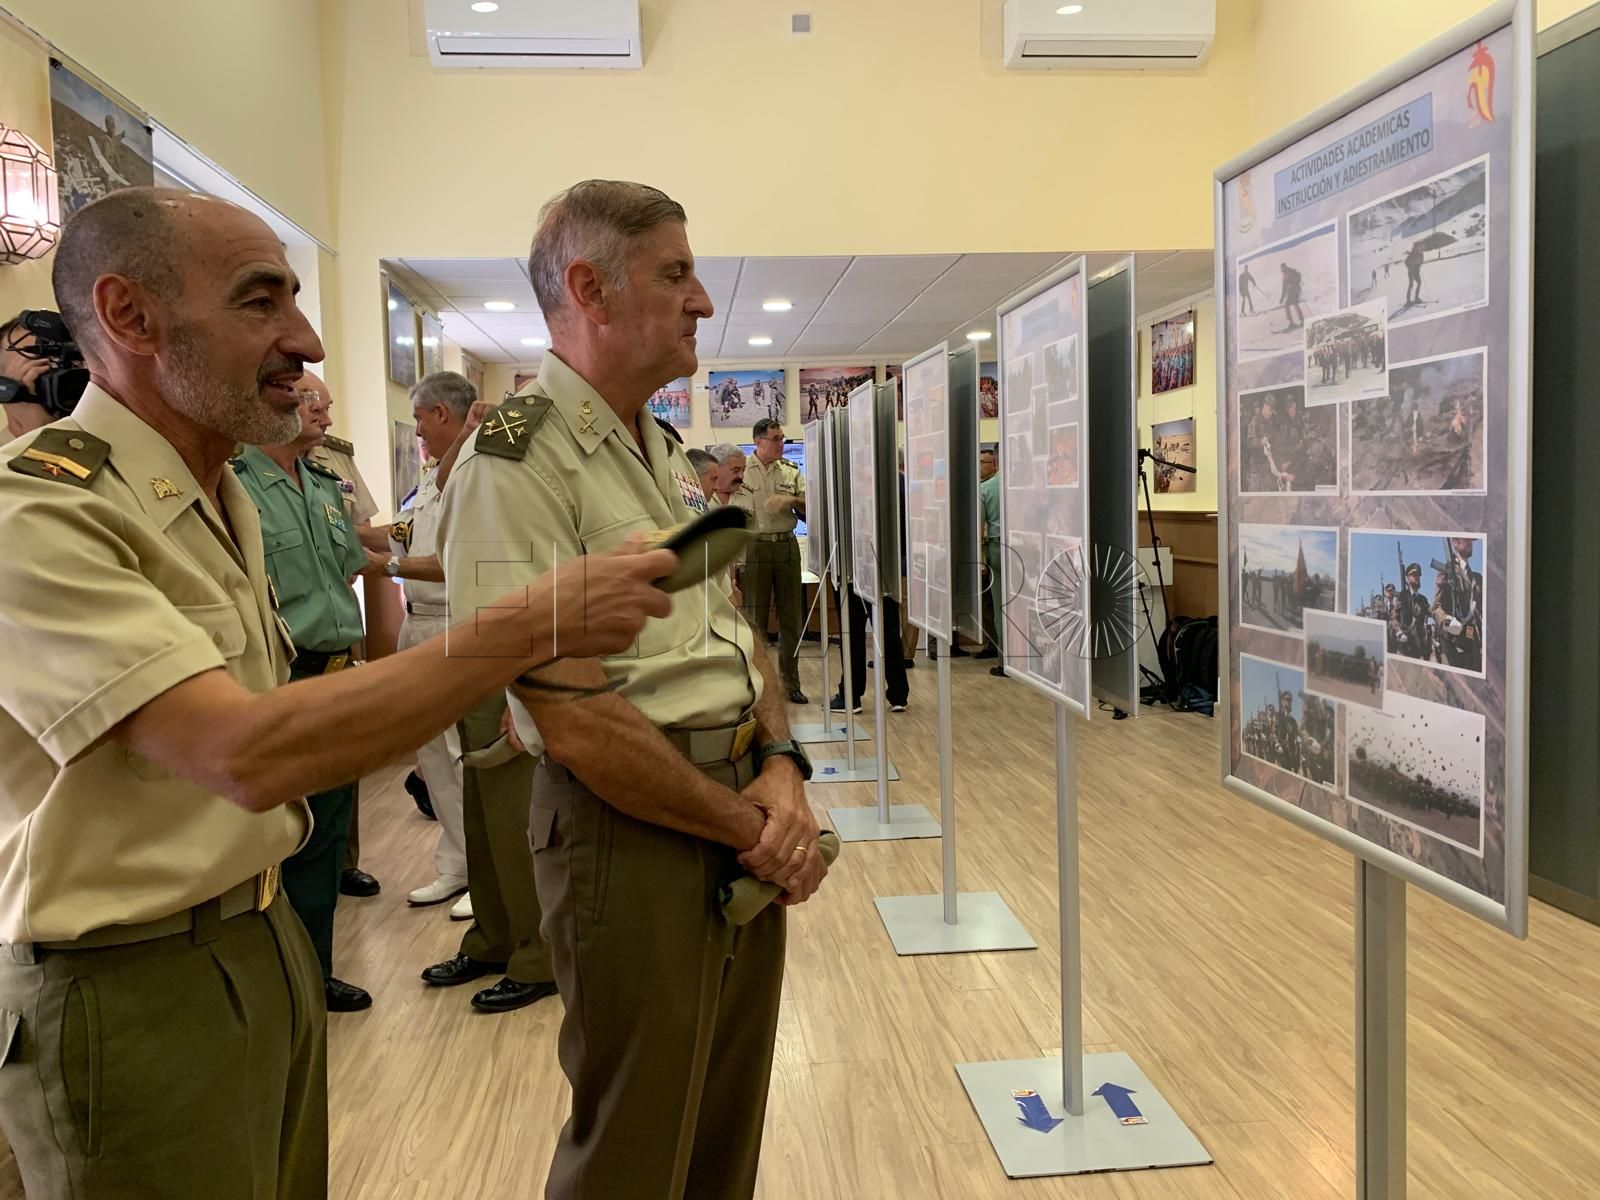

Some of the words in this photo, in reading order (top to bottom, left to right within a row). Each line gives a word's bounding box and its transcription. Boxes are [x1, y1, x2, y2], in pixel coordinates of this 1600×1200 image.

[1277, 174, 1333, 214] INSTRUCCIÓN
[1334, 172, 1341, 188] Y
[1342, 128, 1430, 185] ADIESTRAMIENTO
[1290, 144, 1345, 185] ACTIVIDADES
[1346, 110, 1410, 158] ACADEMICAS
